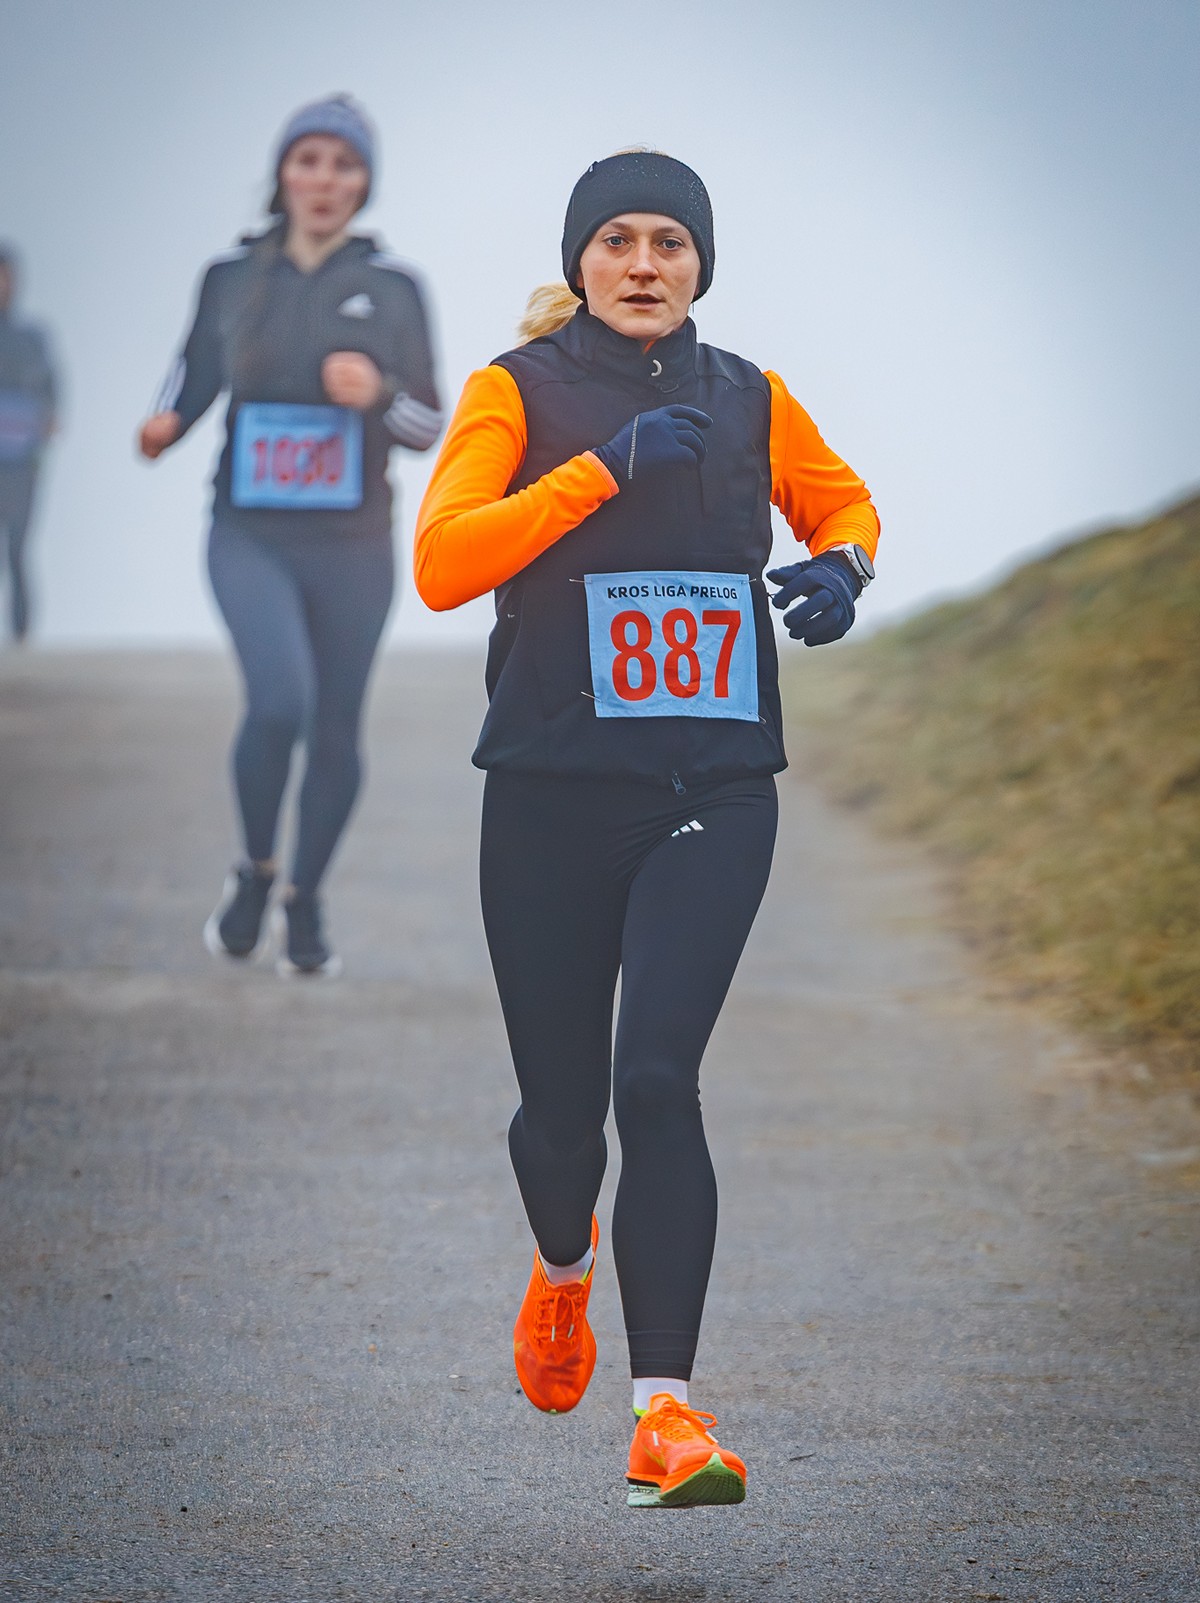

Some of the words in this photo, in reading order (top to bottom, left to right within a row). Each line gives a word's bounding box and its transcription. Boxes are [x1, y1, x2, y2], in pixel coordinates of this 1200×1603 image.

[607, 585, 650, 599] KROS
[654, 585, 687, 597] LIGA
[690, 585, 738, 600] PRELOG
[610, 607, 742, 701] 887
